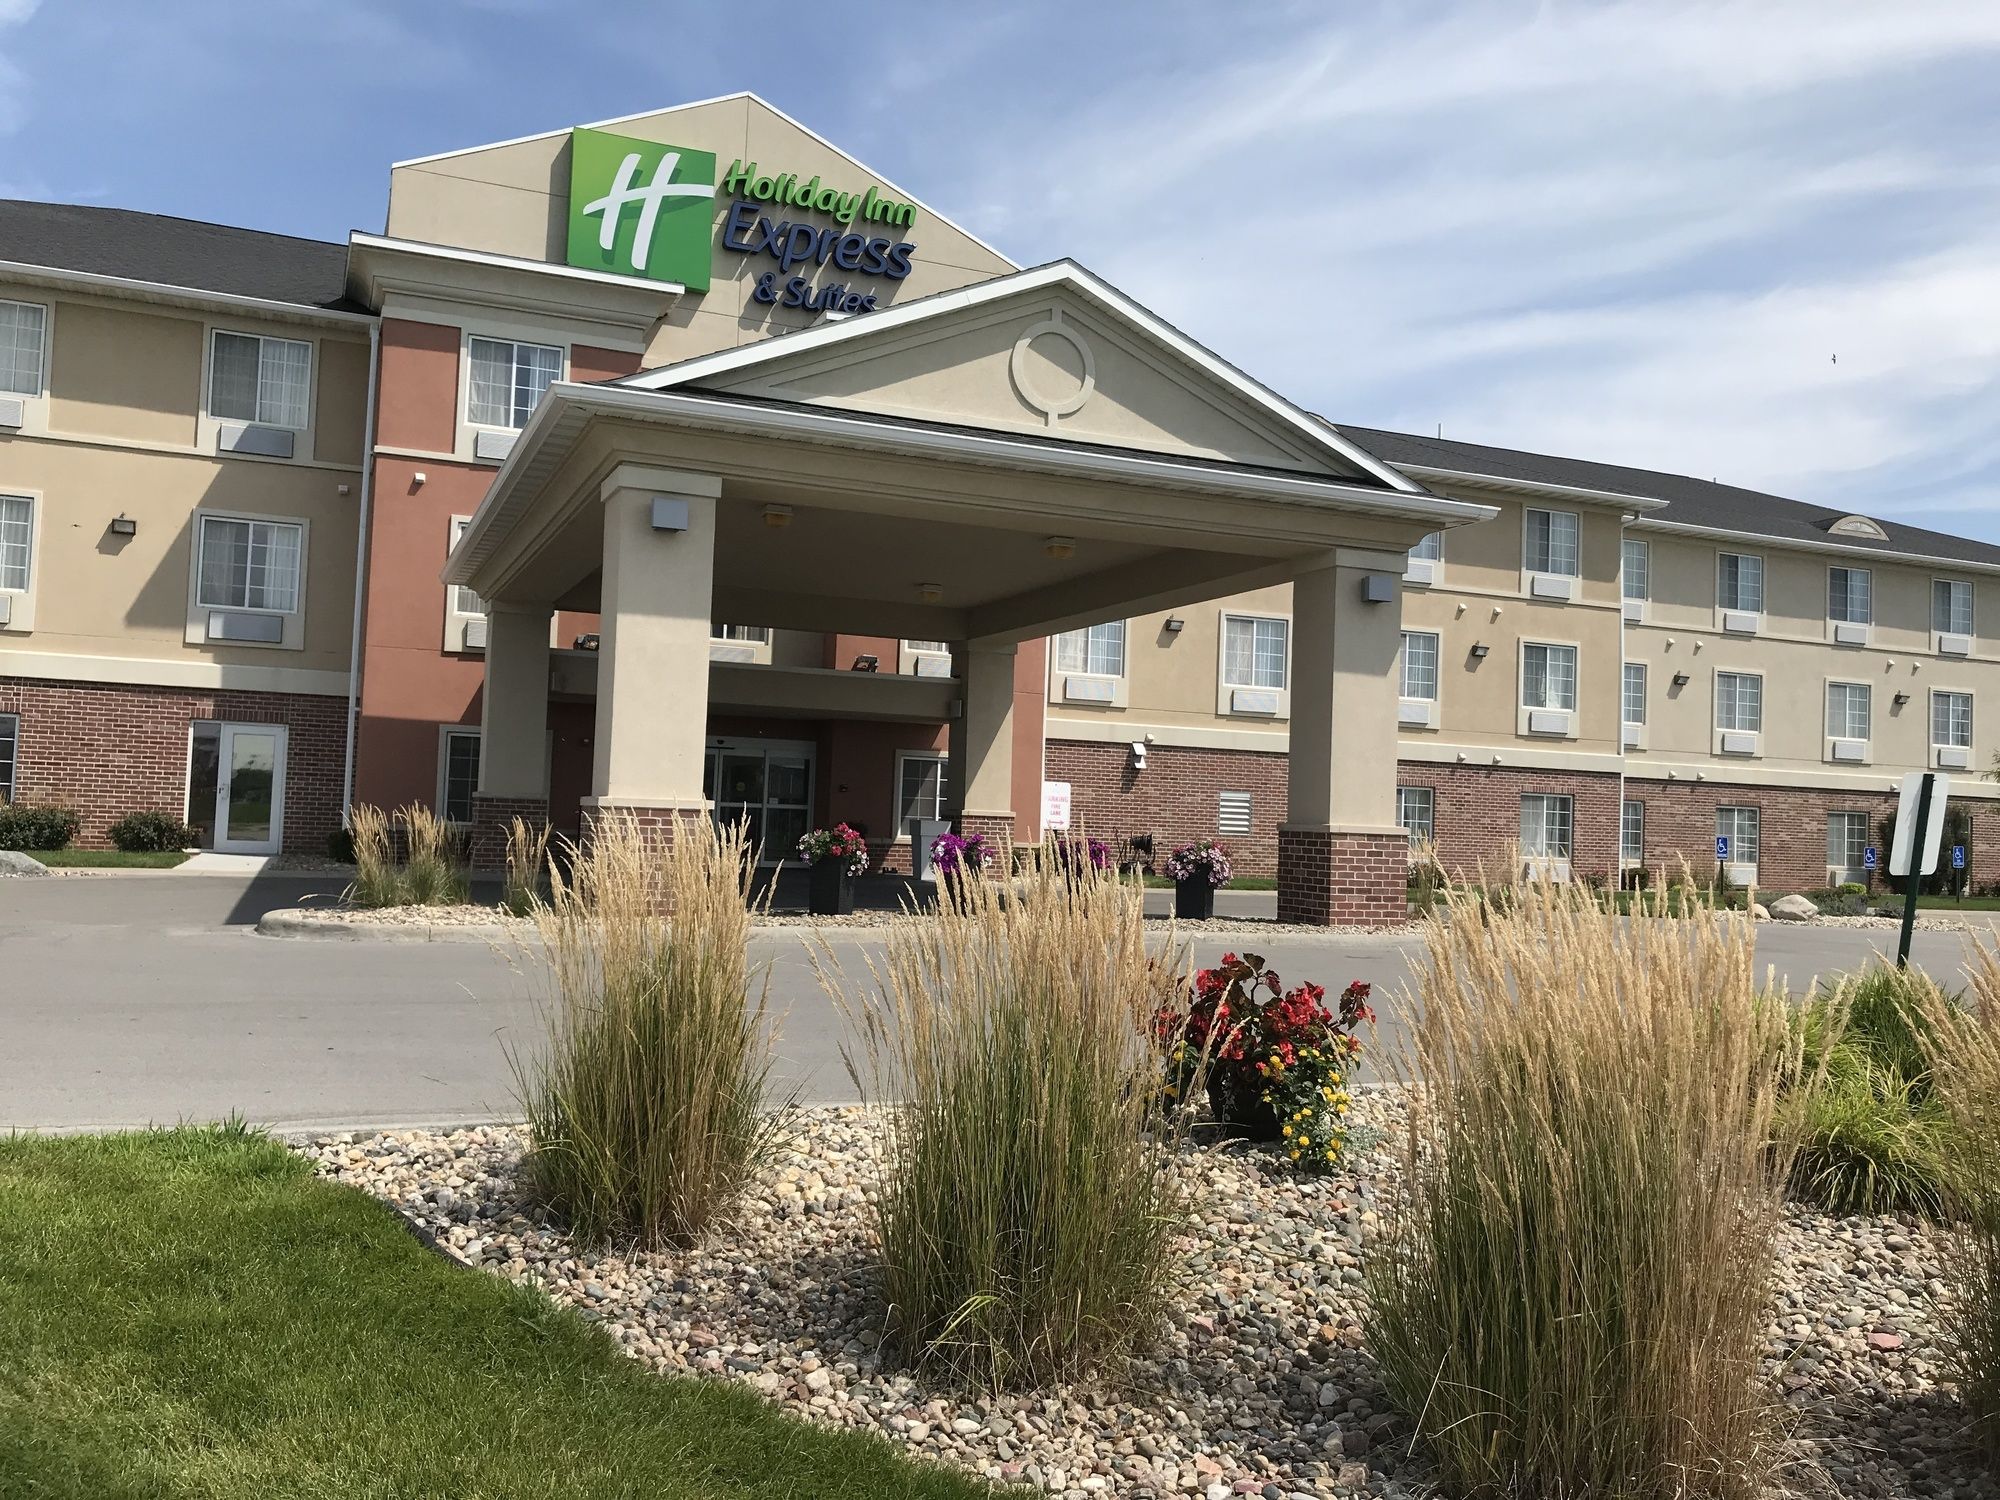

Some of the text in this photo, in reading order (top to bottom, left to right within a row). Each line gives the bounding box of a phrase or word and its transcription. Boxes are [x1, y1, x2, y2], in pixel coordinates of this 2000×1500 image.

[724, 159, 917, 228] Holiday Inn
[722, 201, 914, 280] Express
[753, 272, 877, 312] & Suites
